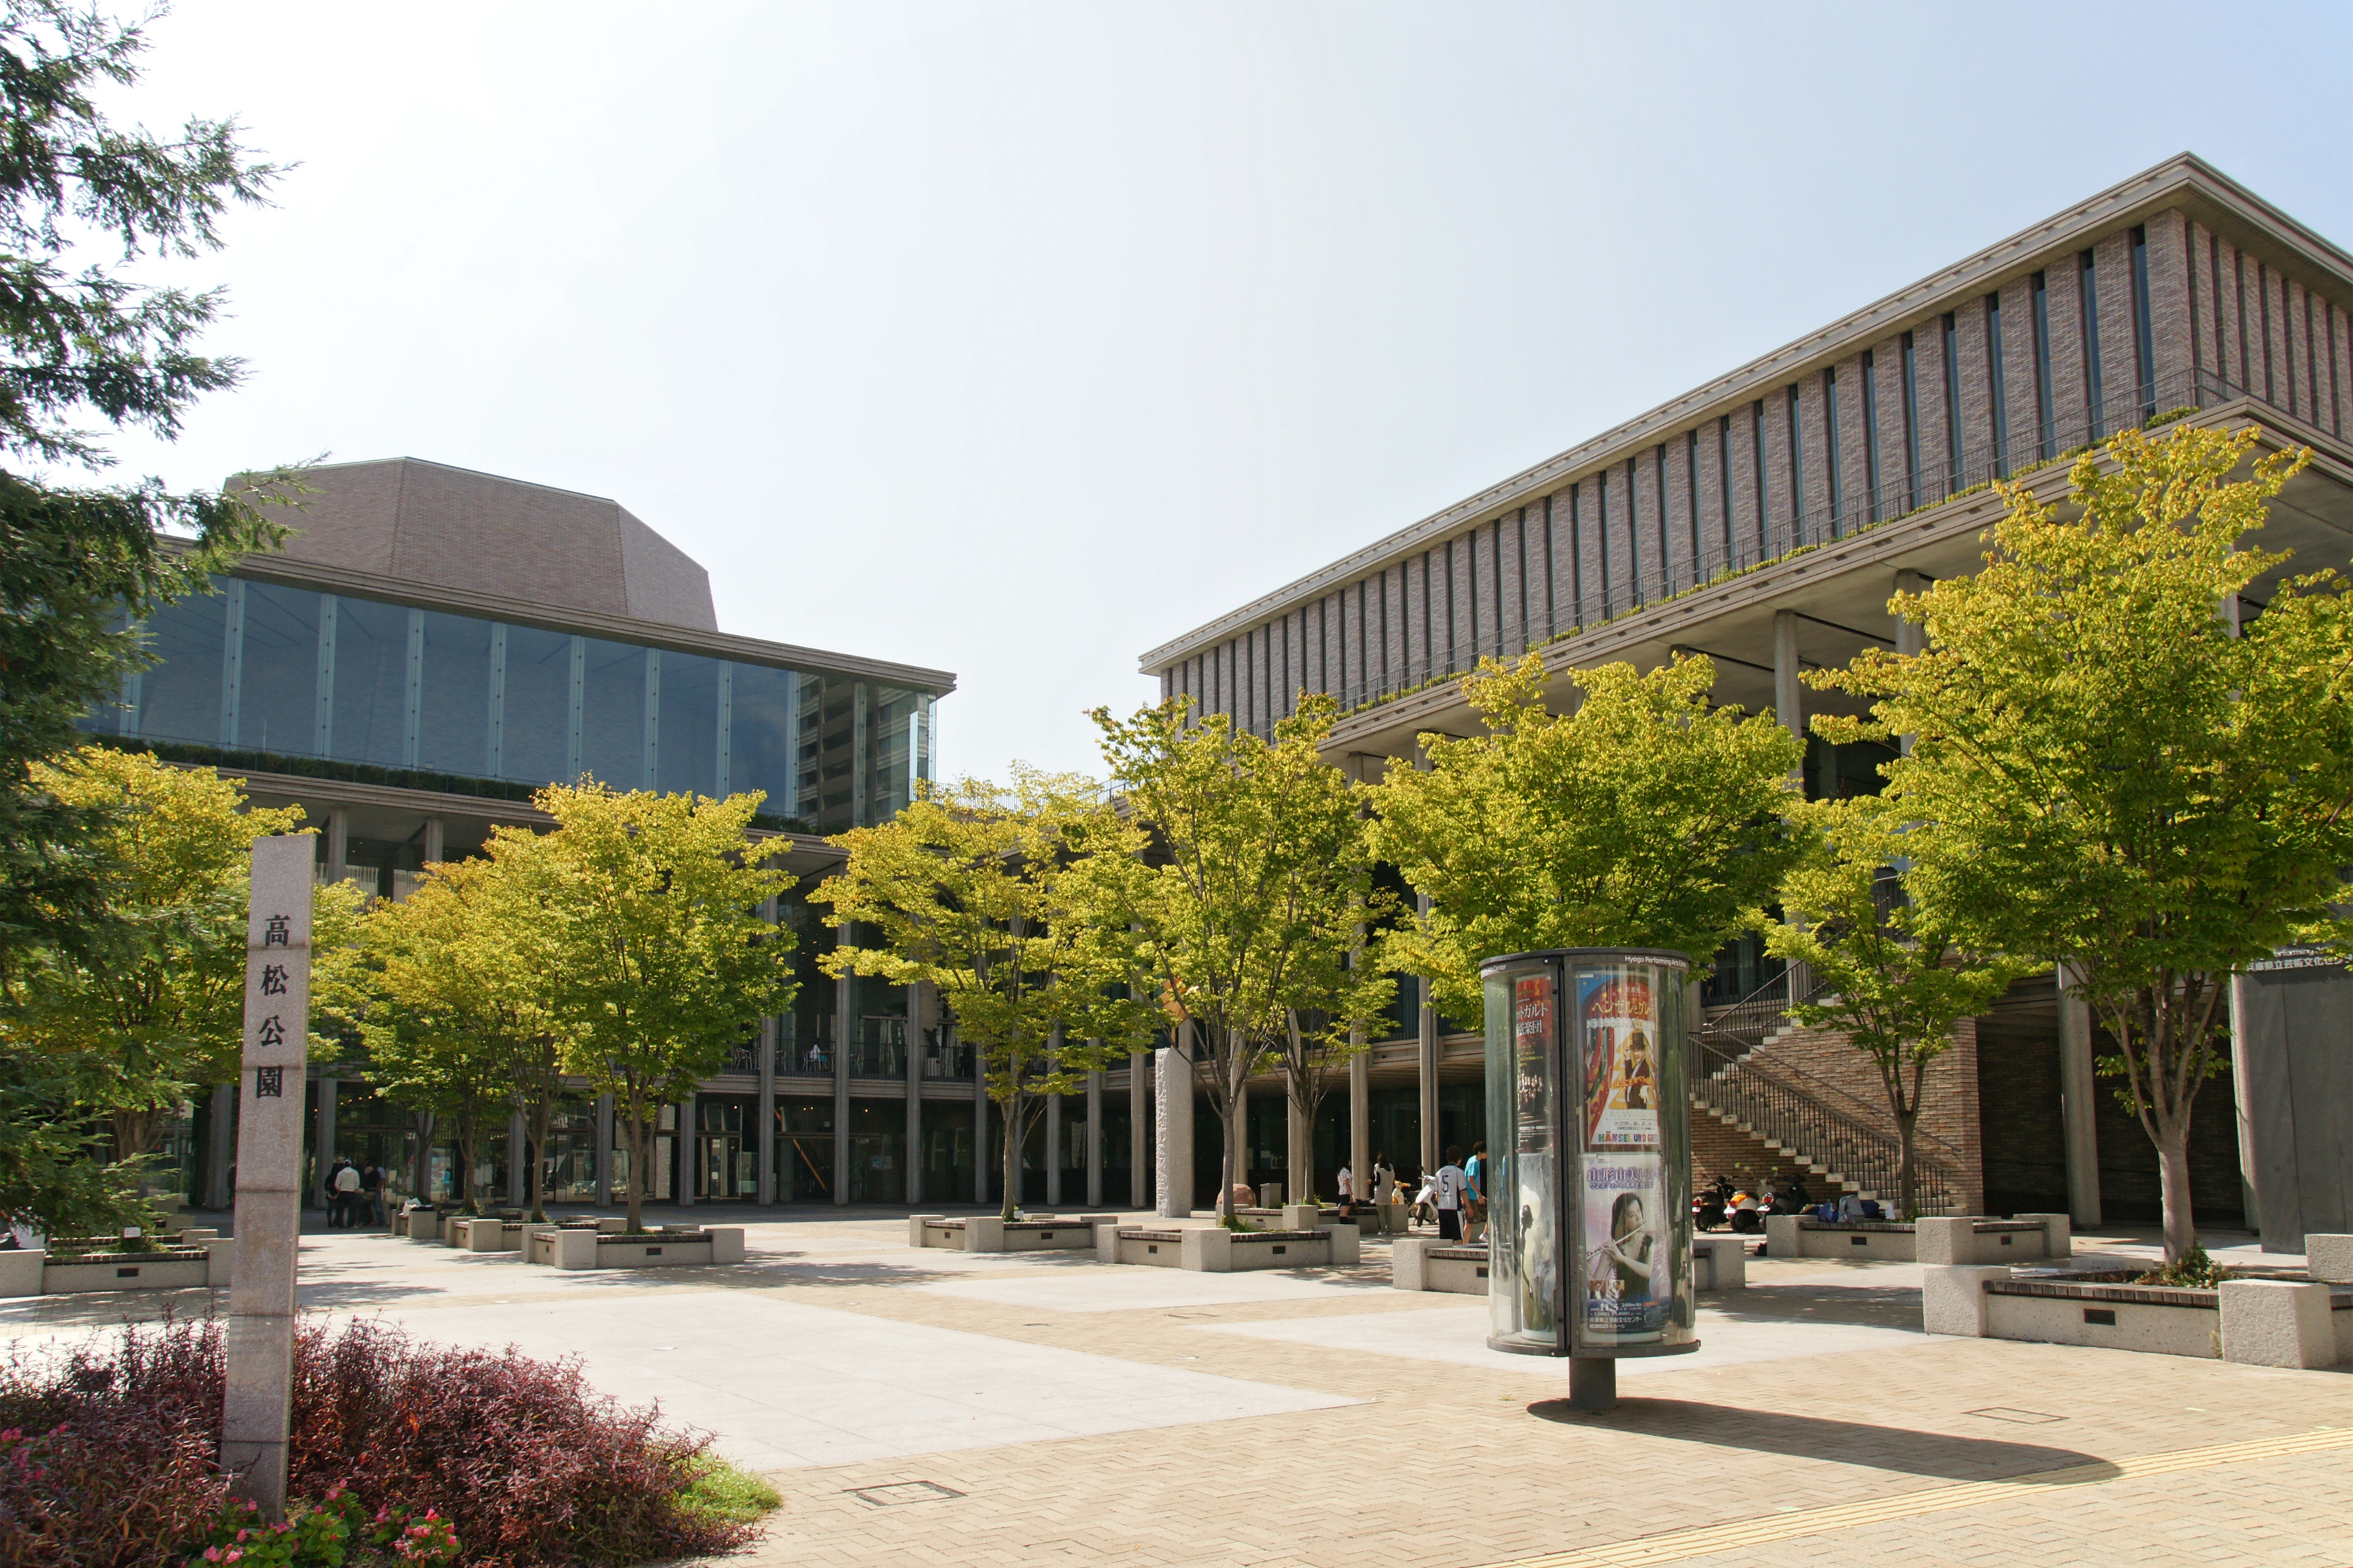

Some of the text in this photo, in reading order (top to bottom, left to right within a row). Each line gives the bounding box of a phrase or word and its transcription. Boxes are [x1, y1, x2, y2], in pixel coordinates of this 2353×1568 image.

[1624, 956, 1644, 964] Hyogo
[257, 914, 290, 1098] 高松公園
[1598, 1131, 1632, 1142] HÄNSEL
[1633, 1134, 1646, 1142] UND
[1442, 1175, 1449, 1192] 5
